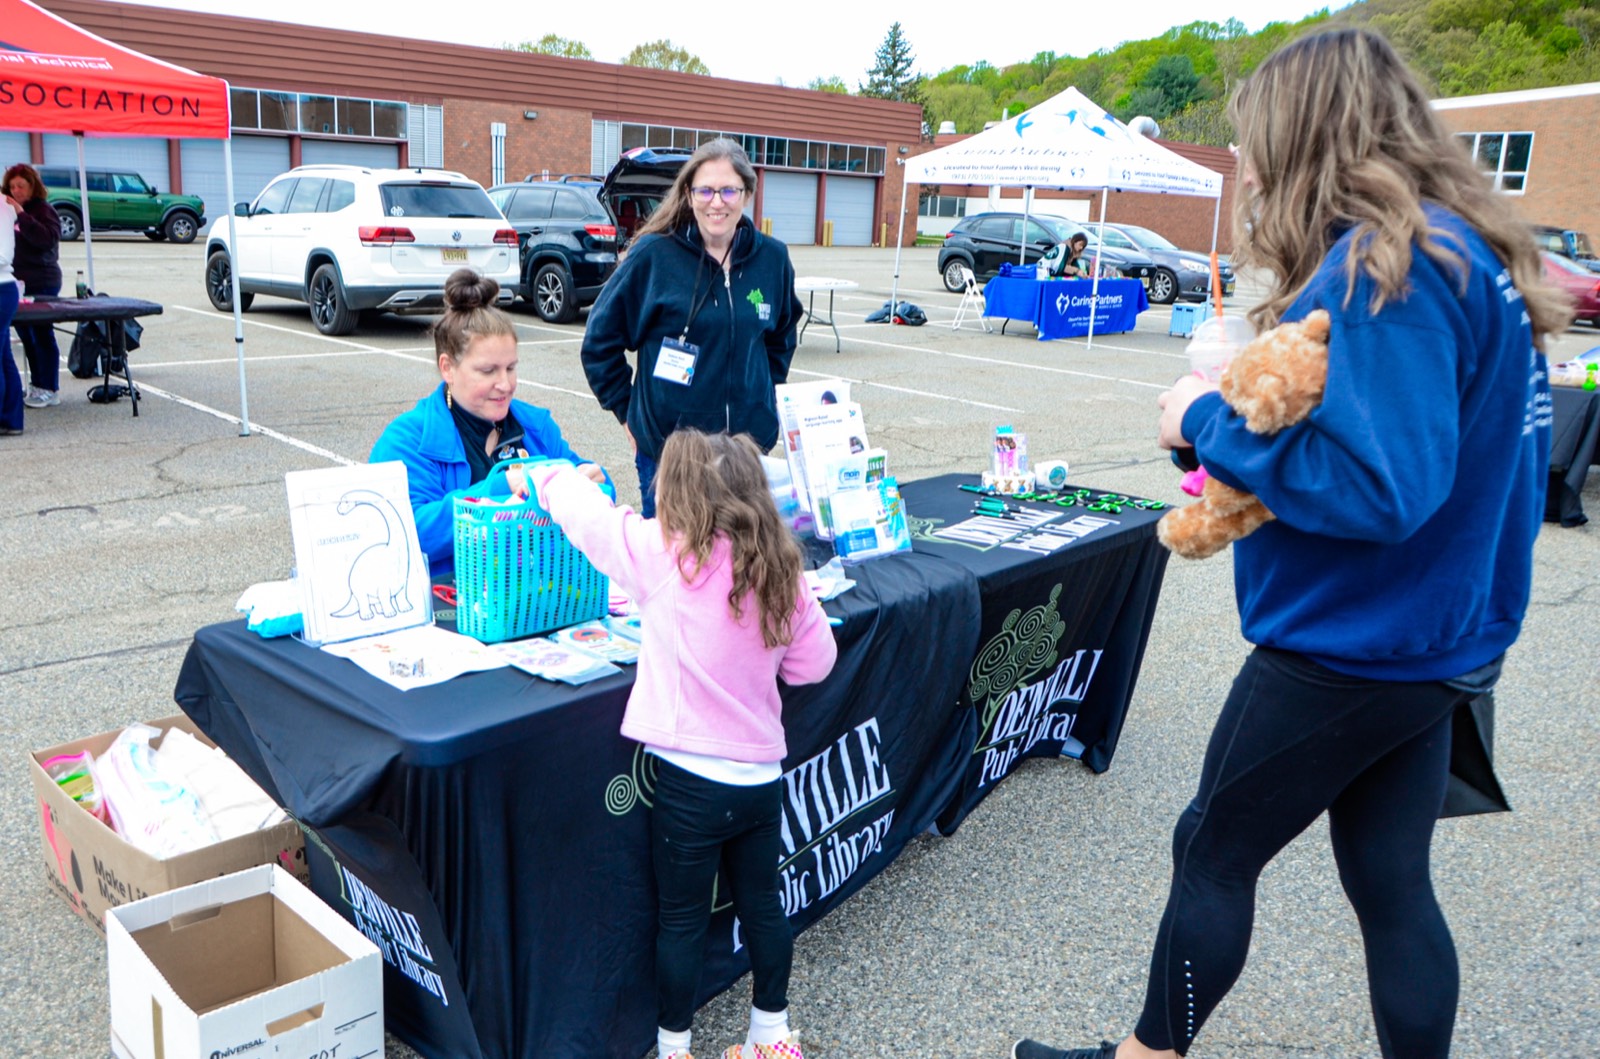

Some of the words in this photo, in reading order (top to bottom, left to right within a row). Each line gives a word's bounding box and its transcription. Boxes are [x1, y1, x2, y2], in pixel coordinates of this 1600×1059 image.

[25, 55, 113, 70] Technical
[1096, 294, 1123, 305] Partners
[779, 717, 891, 864] VILLE
[93, 854, 126, 898] Make
[127, 882, 149, 903] Li
[812, 808, 896, 900] Library
[391, 939, 449, 1007] Library
